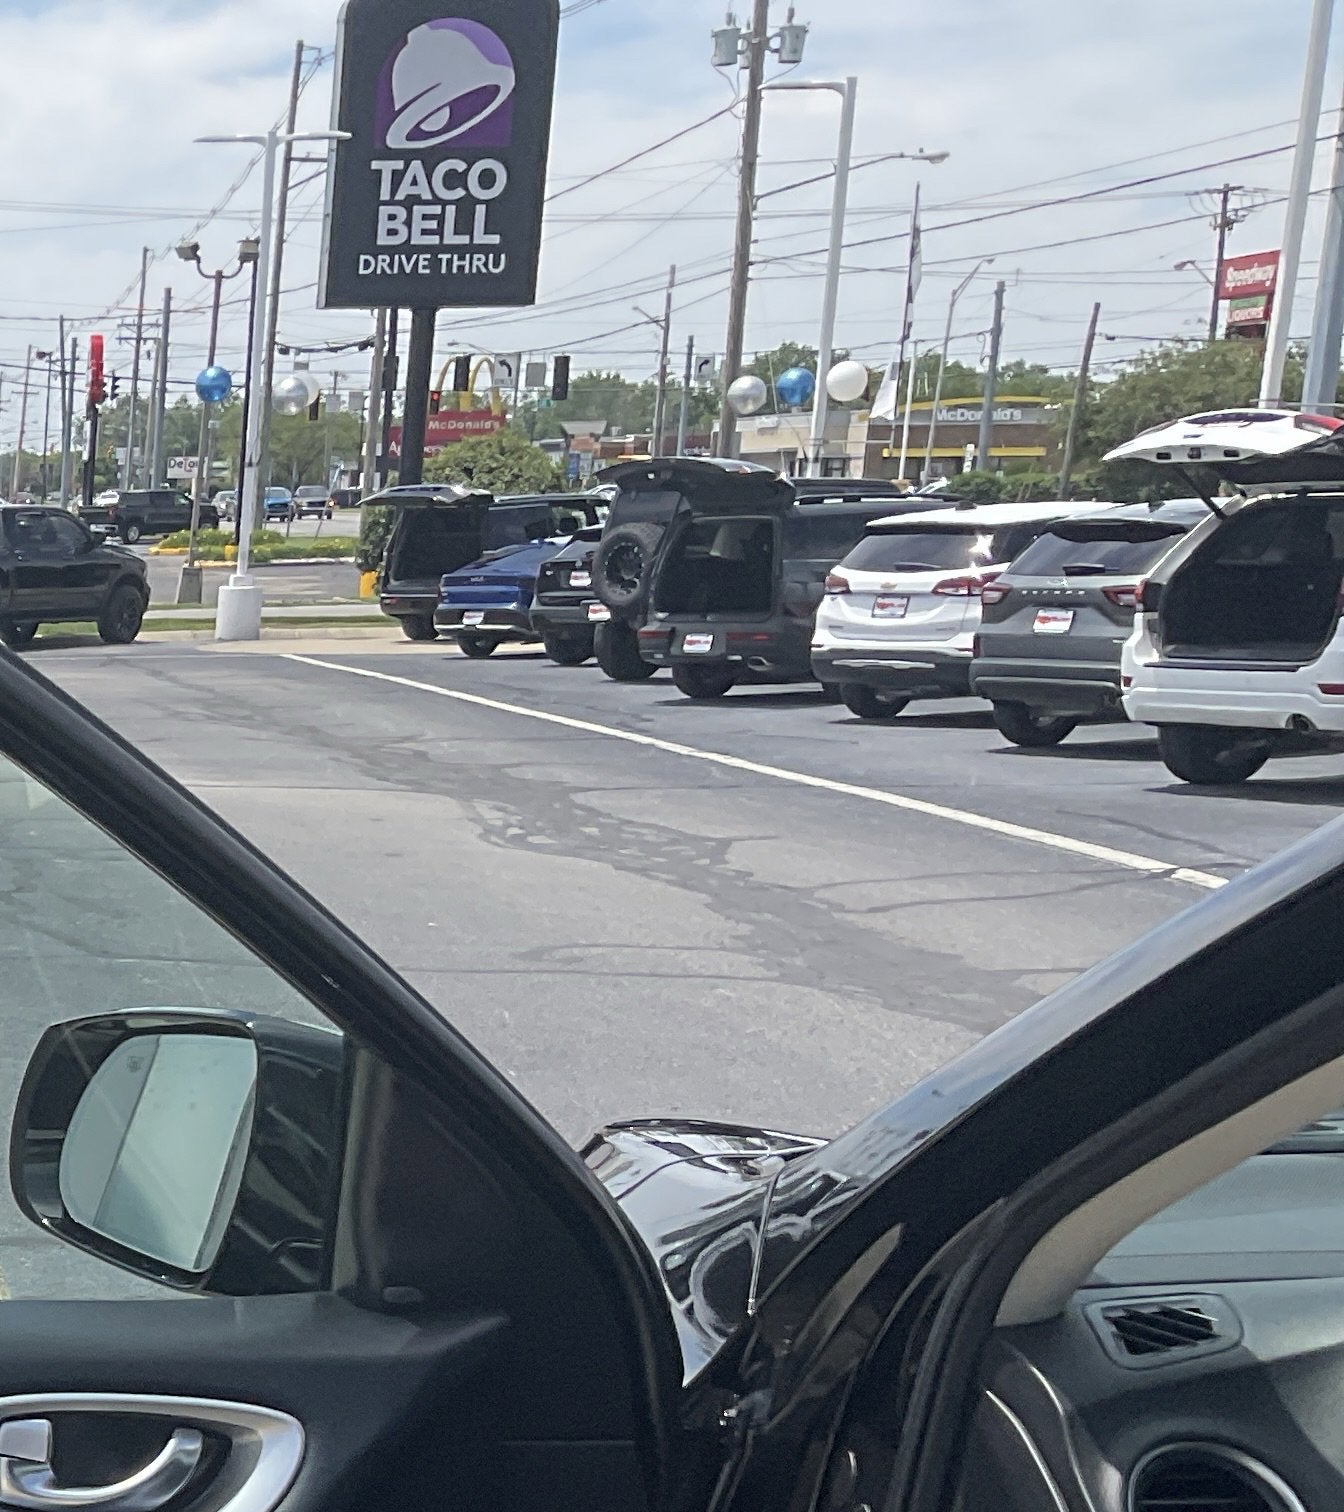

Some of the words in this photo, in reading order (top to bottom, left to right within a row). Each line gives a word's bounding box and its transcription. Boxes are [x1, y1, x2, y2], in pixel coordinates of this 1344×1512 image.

[370, 158, 508, 201] TACO
[376, 204, 501, 245] BELL
[358, 253, 431, 275] DRIVE
[437, 253, 506, 274] THRU
[936, 407, 1022, 421] McDold's
